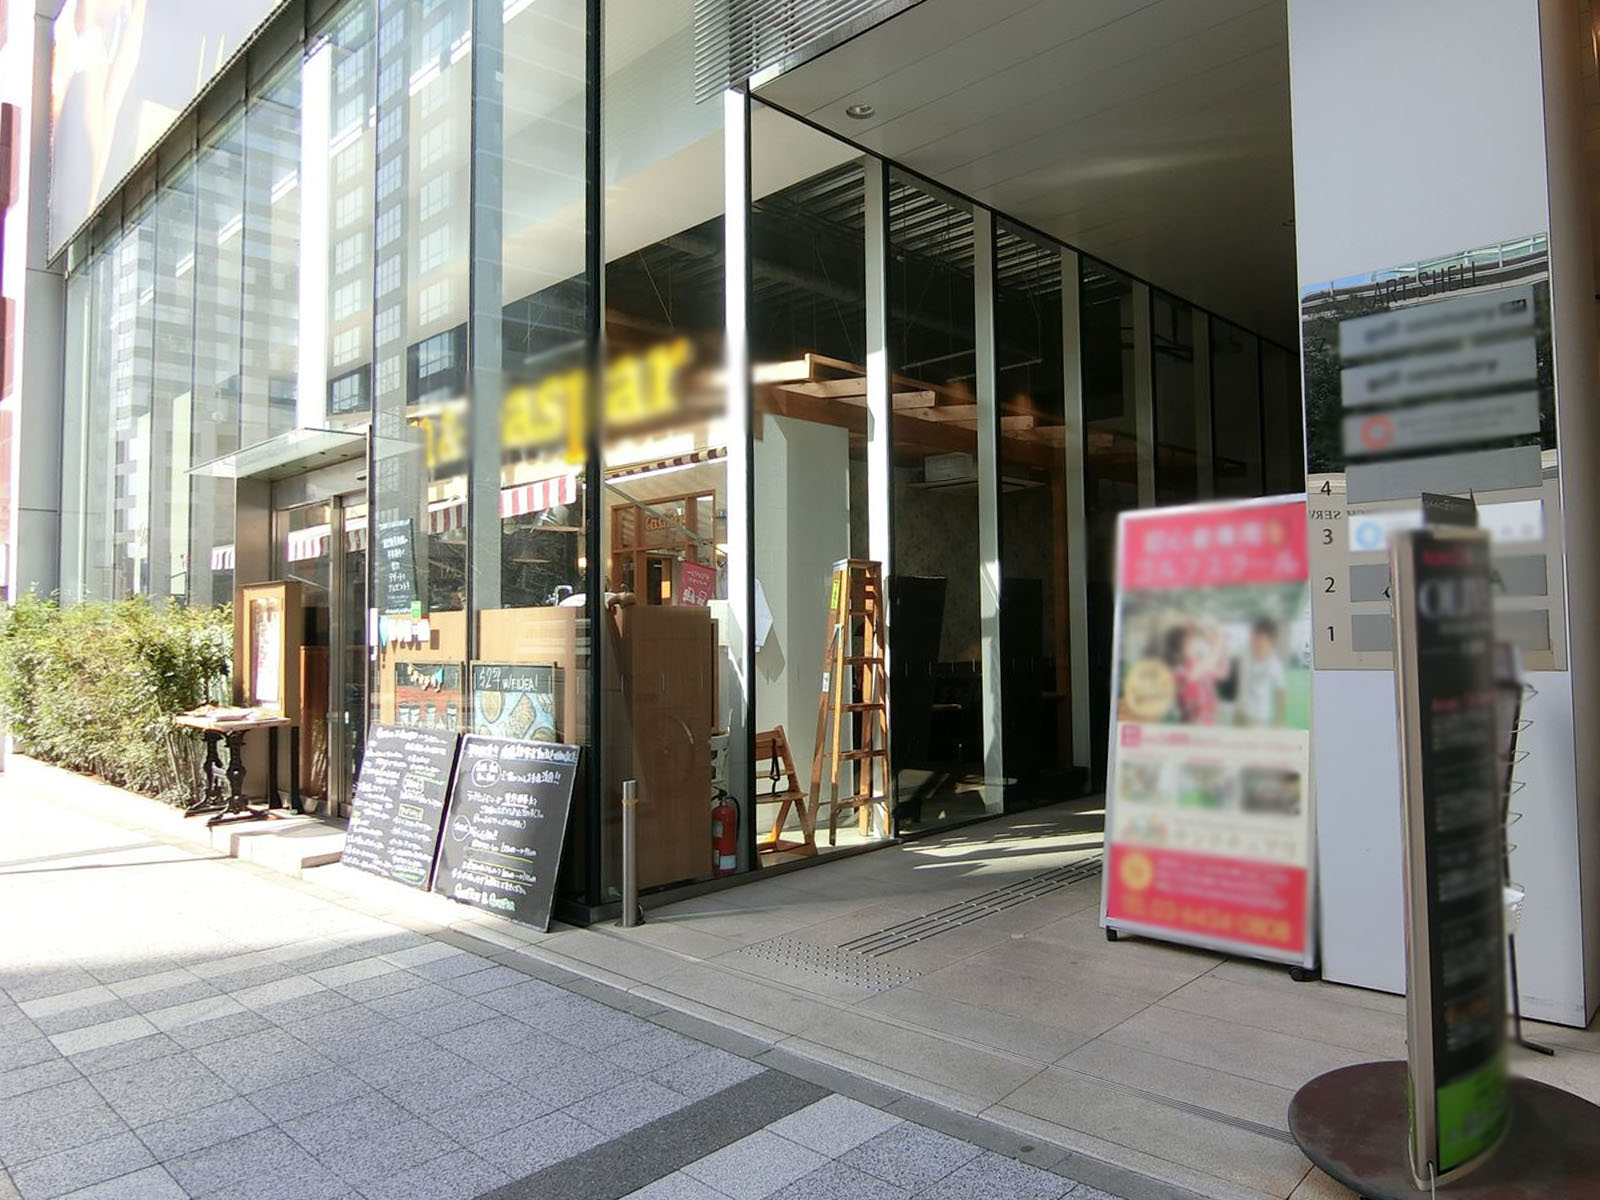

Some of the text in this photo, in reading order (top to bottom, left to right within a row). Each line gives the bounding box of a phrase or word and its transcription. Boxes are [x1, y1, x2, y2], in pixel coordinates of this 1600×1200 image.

[1372, 261, 1480, 307] ART SHELL
[1320, 480, 1332, 496] 4
[1322, 528, 1333, 545] 3
[1324, 576, 1336, 593] 2
[1327, 626, 1335, 642] 1
